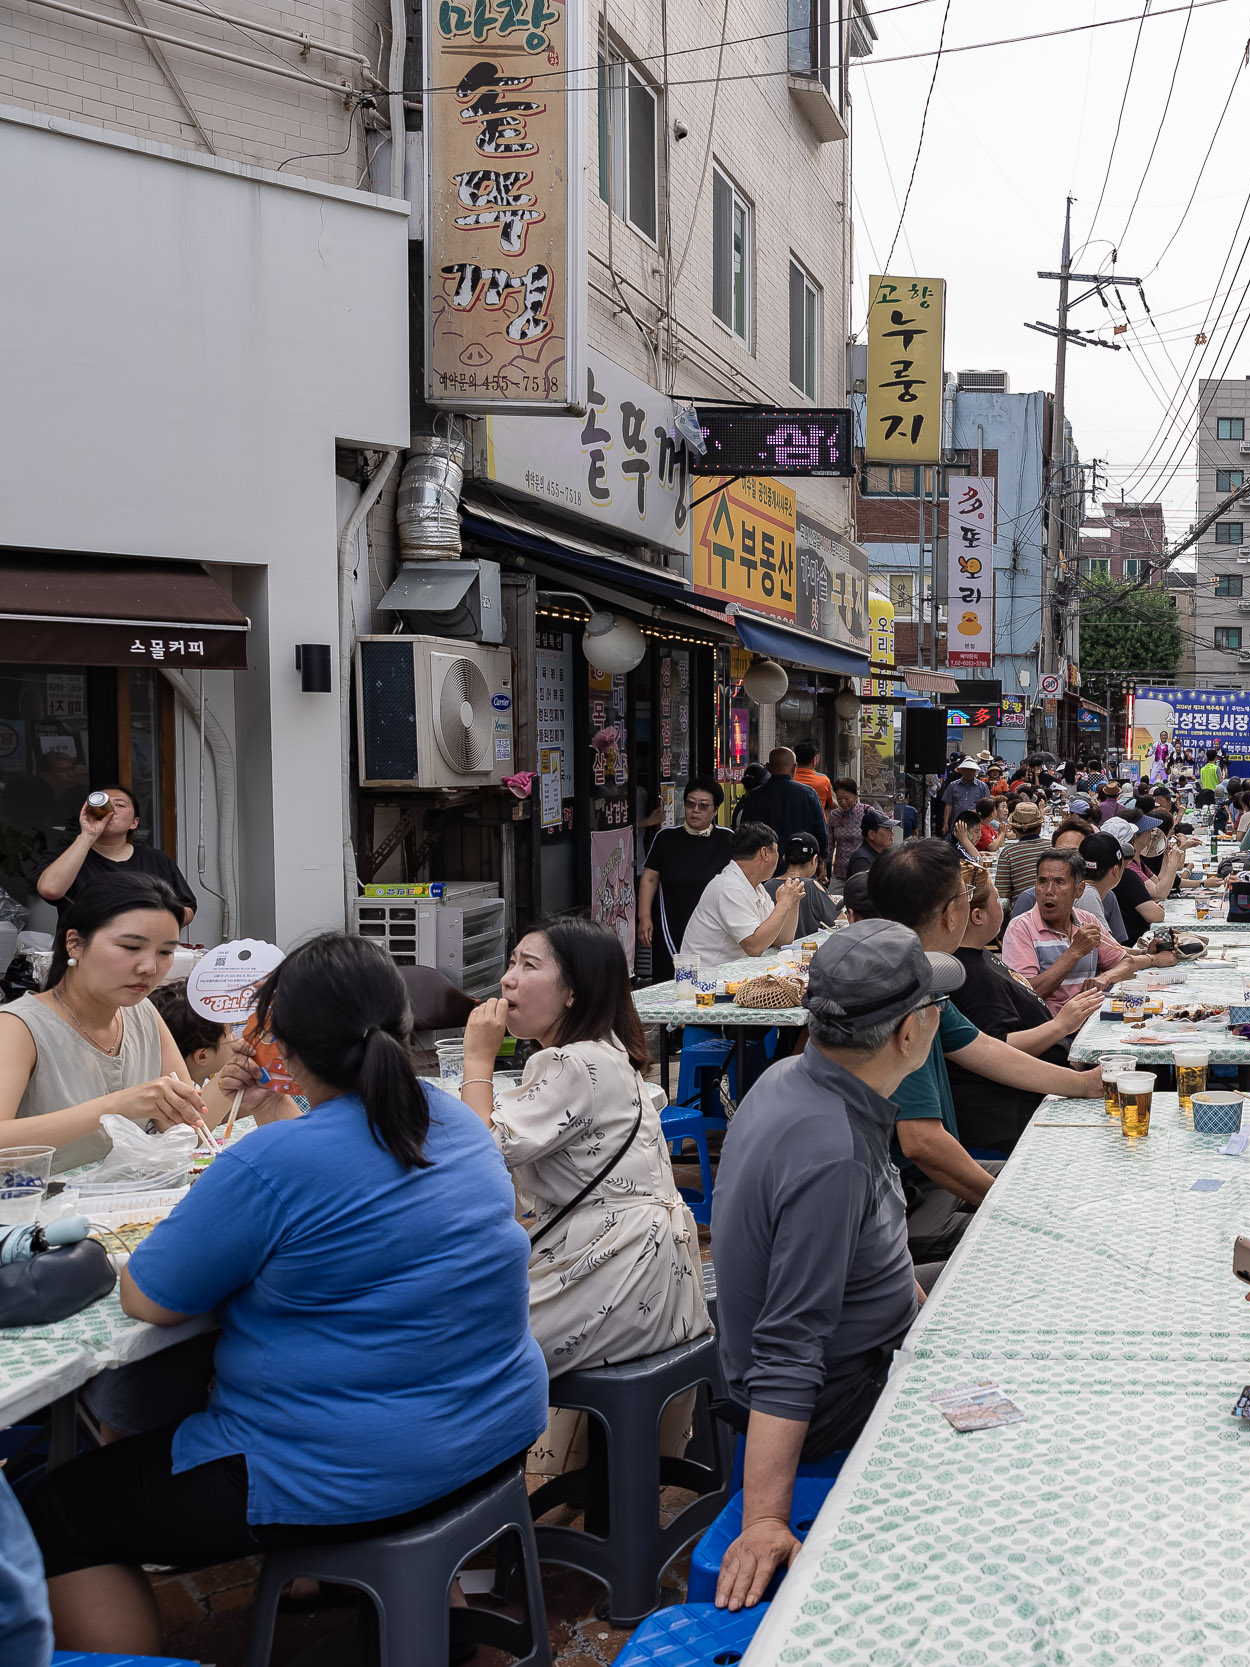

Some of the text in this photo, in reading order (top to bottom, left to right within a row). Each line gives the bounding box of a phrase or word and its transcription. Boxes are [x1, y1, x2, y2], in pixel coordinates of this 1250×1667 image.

[876, 284, 934, 309] 고향
[439, 372, 478, 392] 예약문의
[878, 310, 928, 445] 누룽지
[524, 469, 583, 506] 예약문의 455-7518
[958, 486, 983, 515] 多
[130, 640, 204, 660] 스몰커피
[1165, 712, 1249, 731] 신성전통시장
[605, 799, 629, 825] 삼겹살
